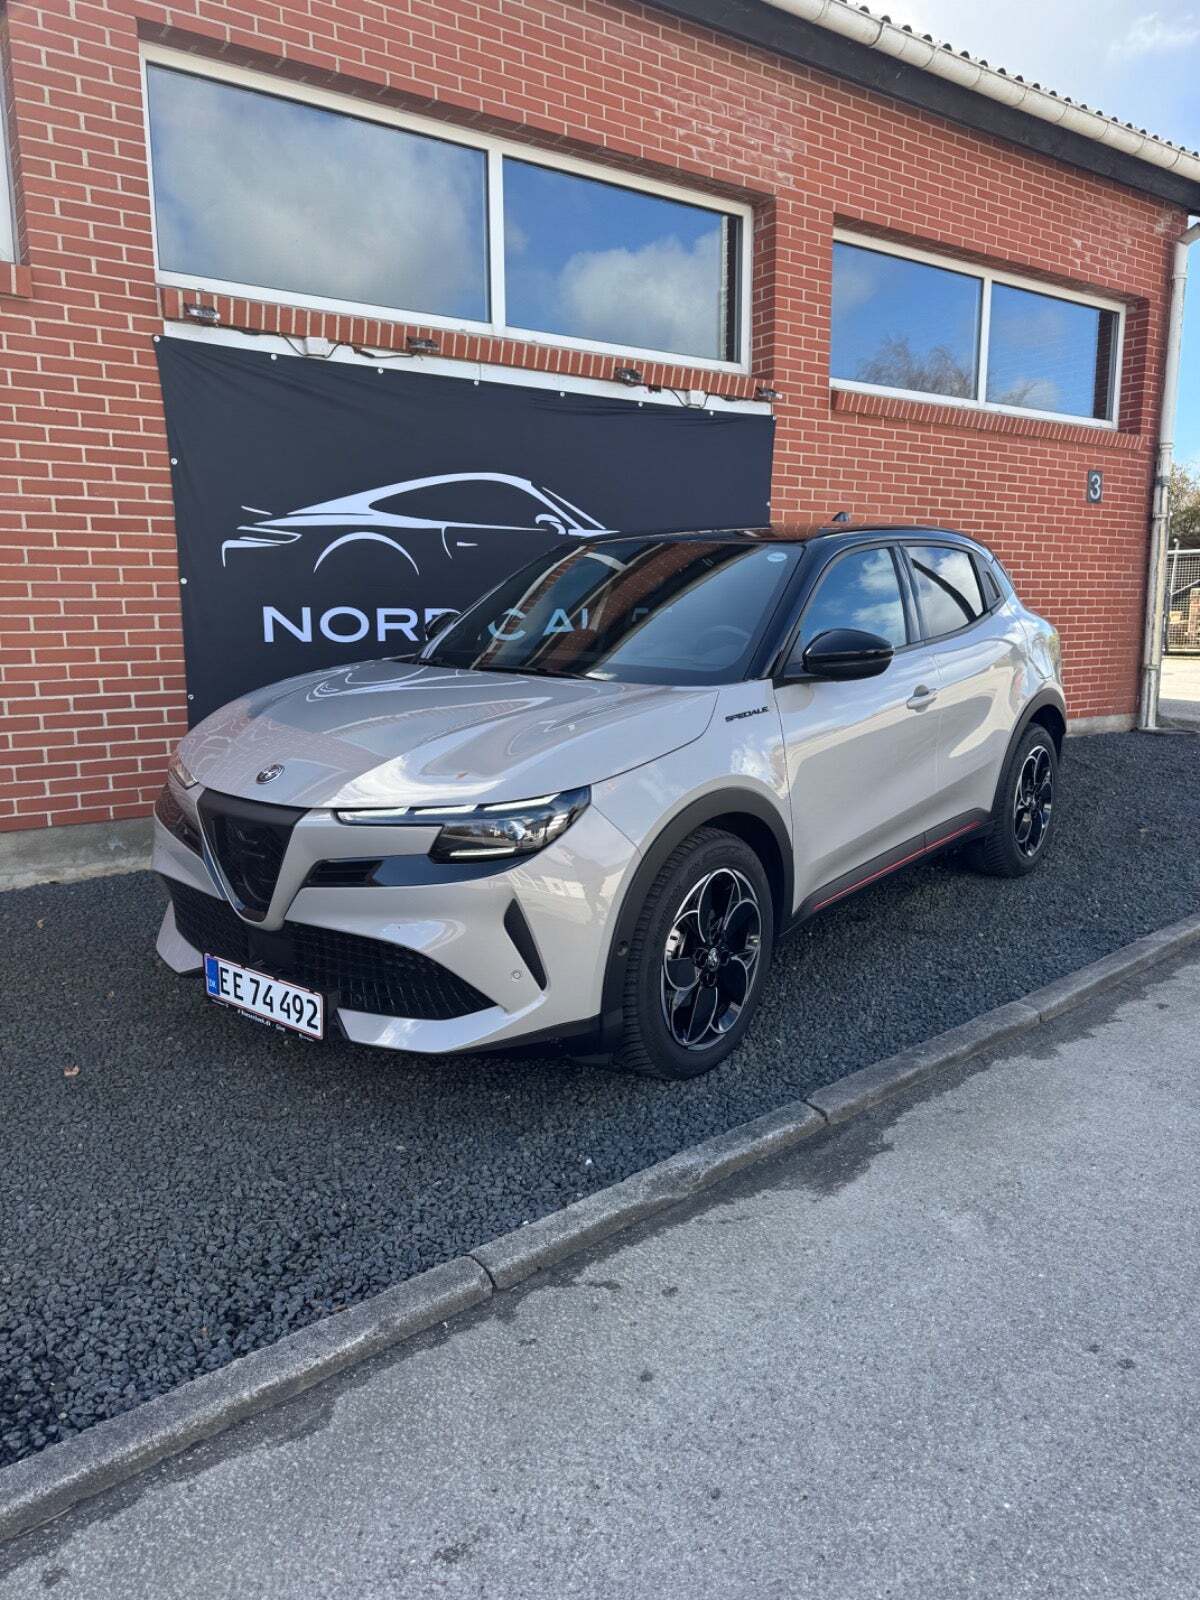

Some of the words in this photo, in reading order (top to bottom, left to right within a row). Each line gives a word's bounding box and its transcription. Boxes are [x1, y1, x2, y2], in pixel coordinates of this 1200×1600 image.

[1090, 474, 1101, 500] 3
[220, 966, 244, 1001] EE
[249, 977, 274, 1013] 74
[279, 990, 319, 1030] 492
